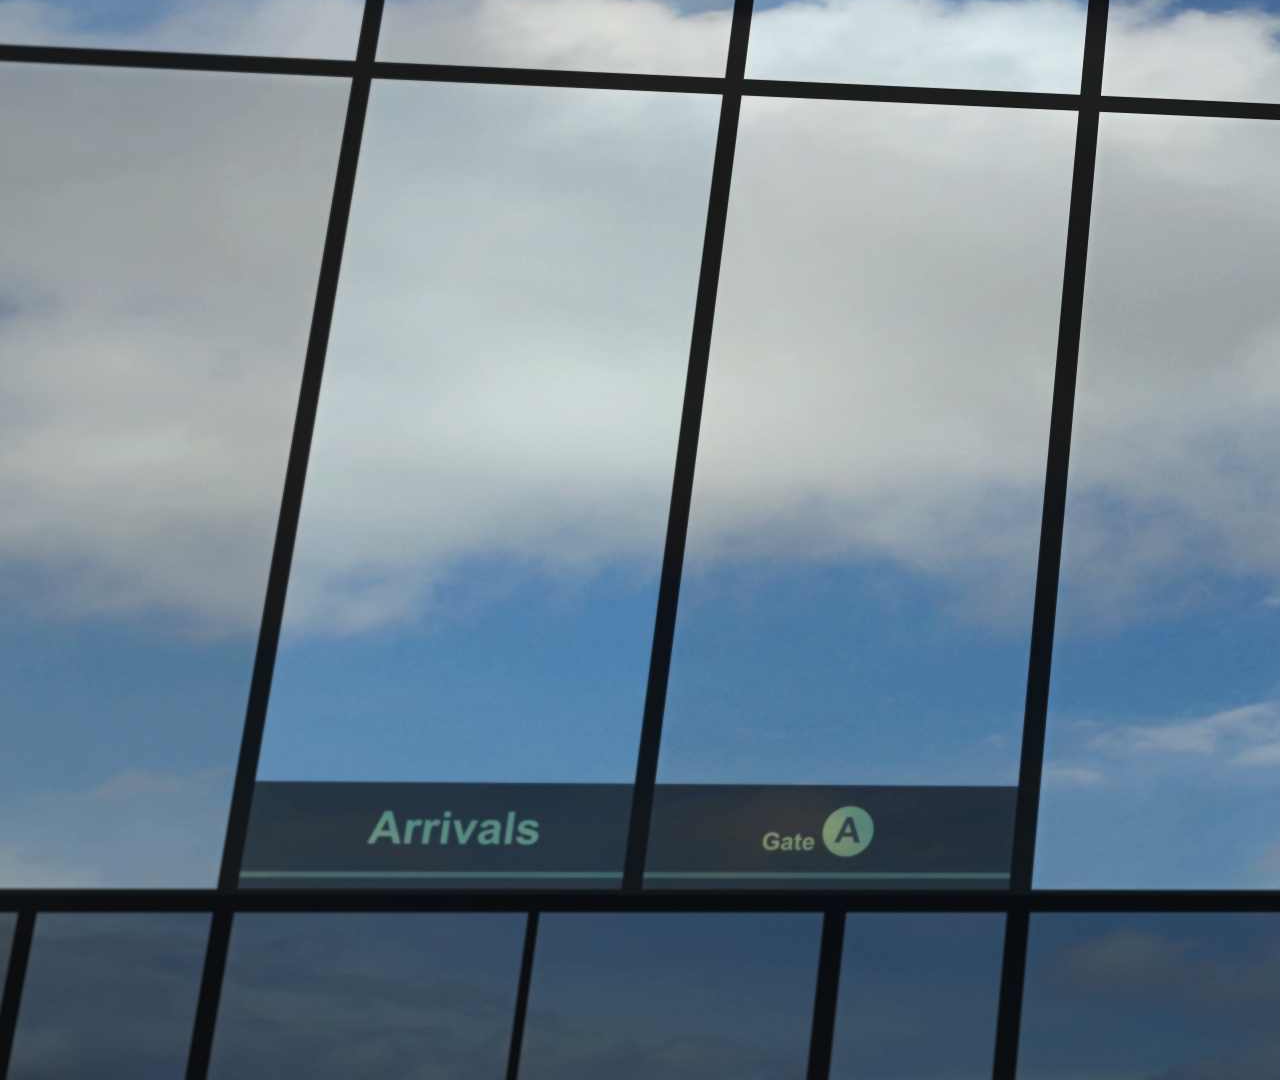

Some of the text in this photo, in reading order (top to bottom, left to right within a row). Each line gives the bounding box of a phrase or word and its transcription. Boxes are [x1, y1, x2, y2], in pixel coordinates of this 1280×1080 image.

[367, 810, 539, 846] Arrivals
[762, 816, 861, 852] Gate A
